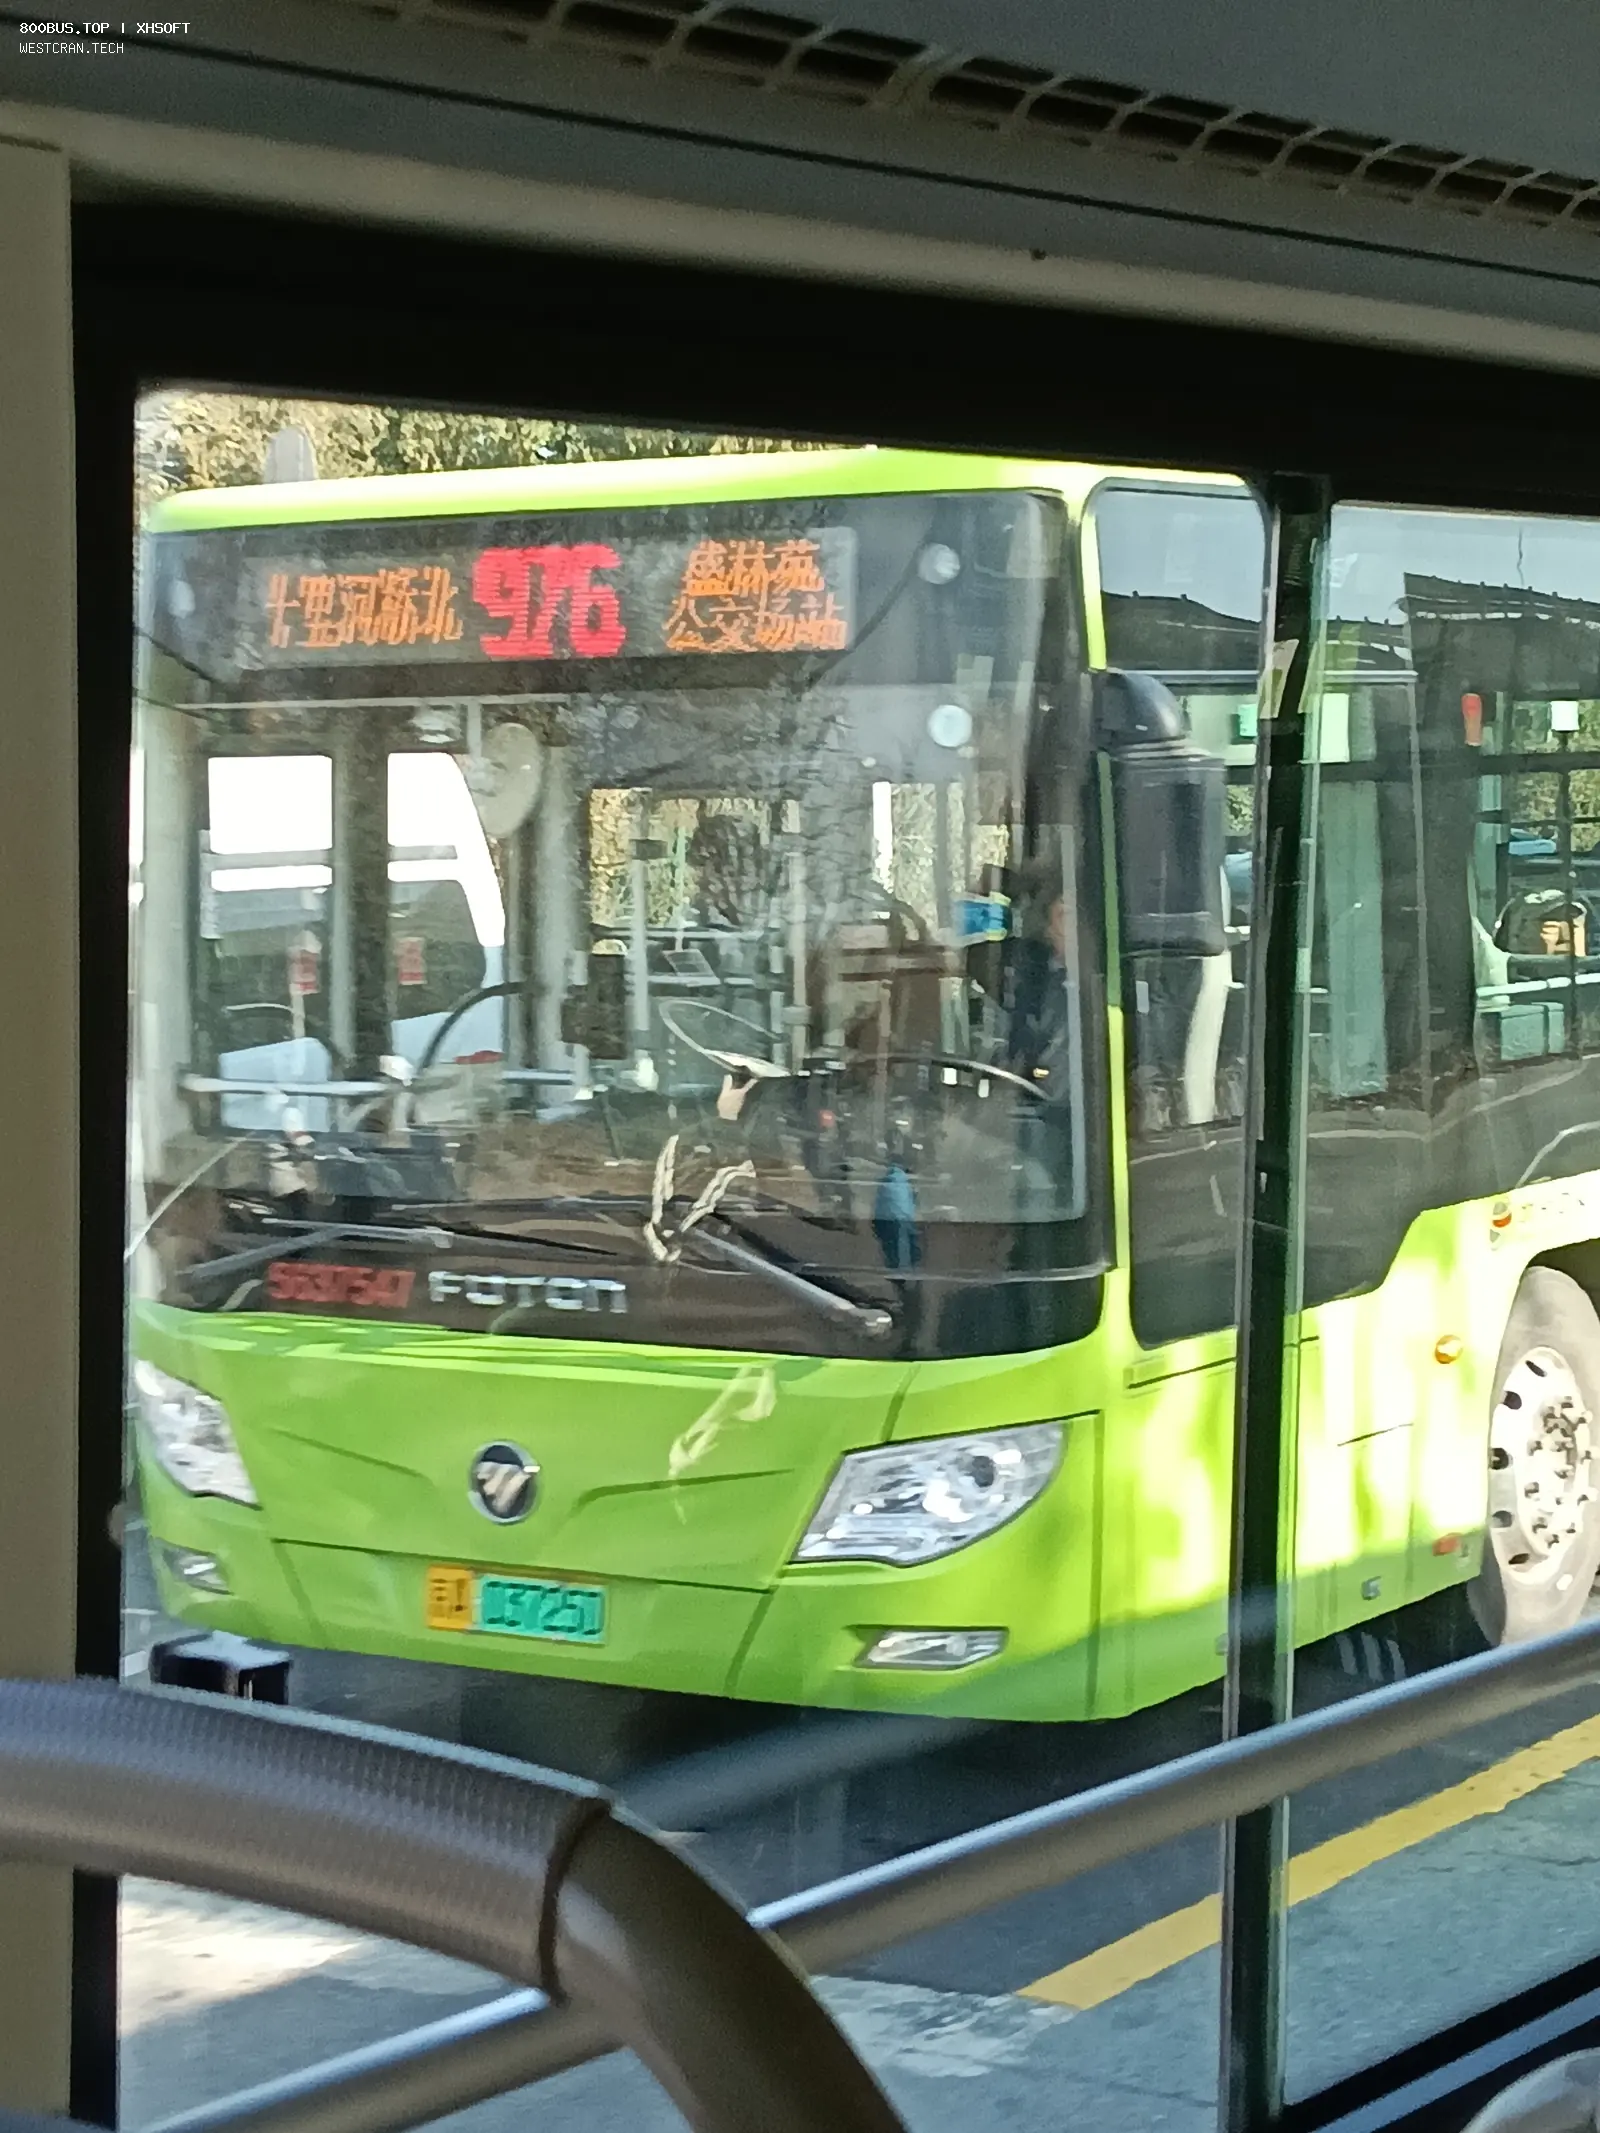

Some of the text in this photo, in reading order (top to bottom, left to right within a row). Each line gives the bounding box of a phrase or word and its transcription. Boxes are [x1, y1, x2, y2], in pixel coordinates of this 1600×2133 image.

[472, 543, 628, 660] 976
[661, 592, 849, 654] 公交场站
[428, 1270, 629, 1314] FOTON
